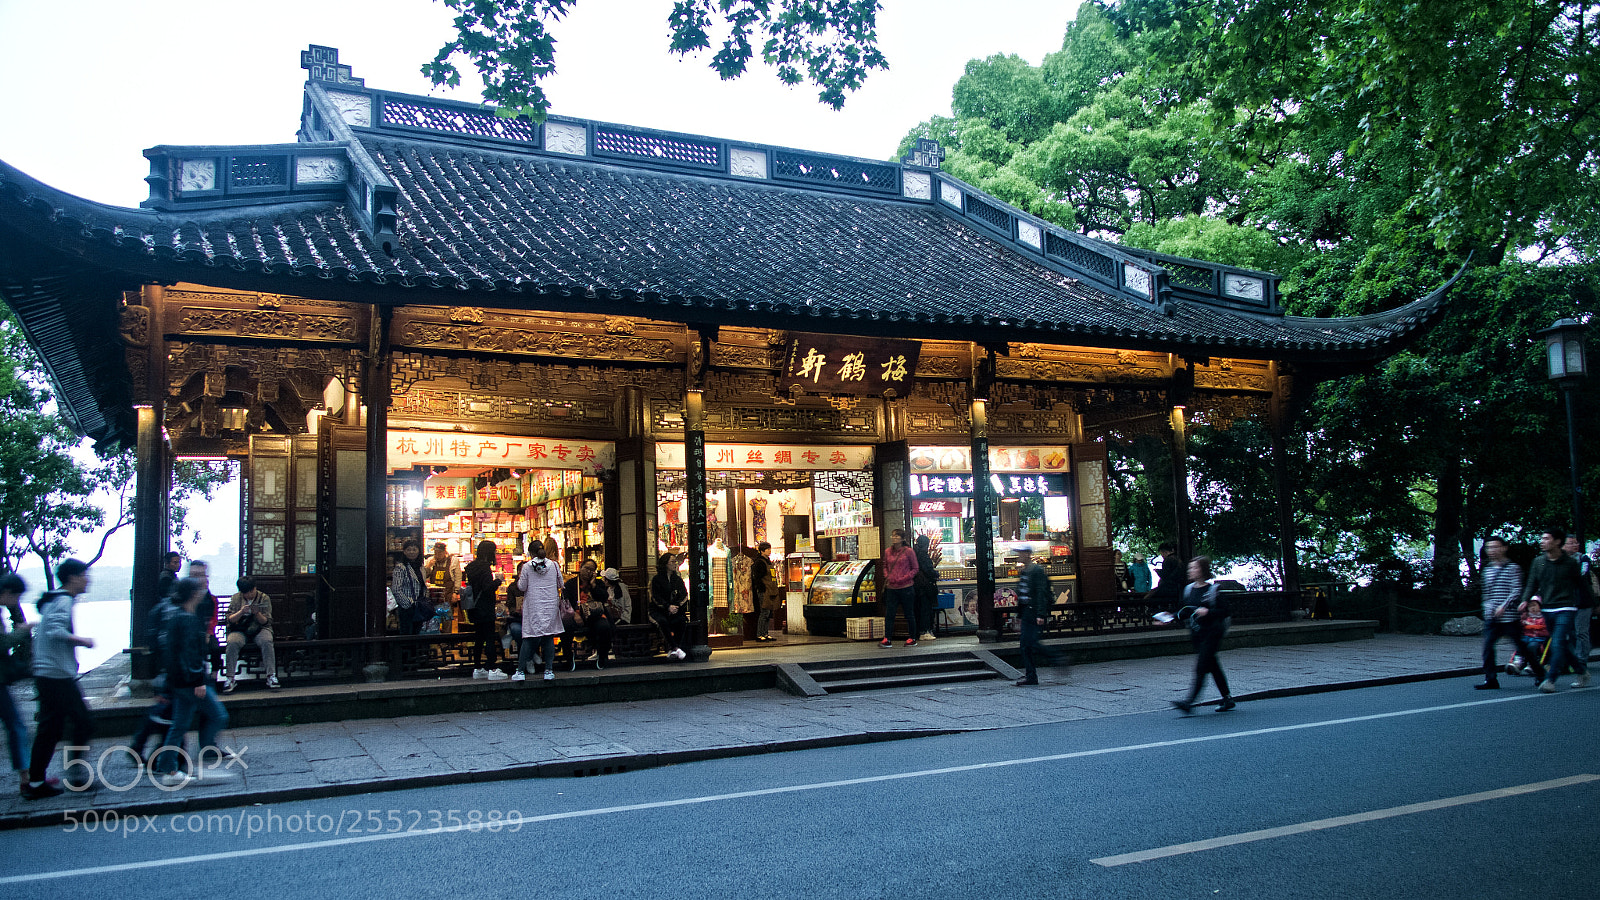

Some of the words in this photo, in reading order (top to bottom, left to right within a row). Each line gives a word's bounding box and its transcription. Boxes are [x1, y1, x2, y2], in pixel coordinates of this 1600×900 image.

[396, 436, 596, 463] 杭州特产厂家专卖
[716, 448, 848, 465] 州丝绸专卖
[425, 485, 468, 500] 厂家直销
